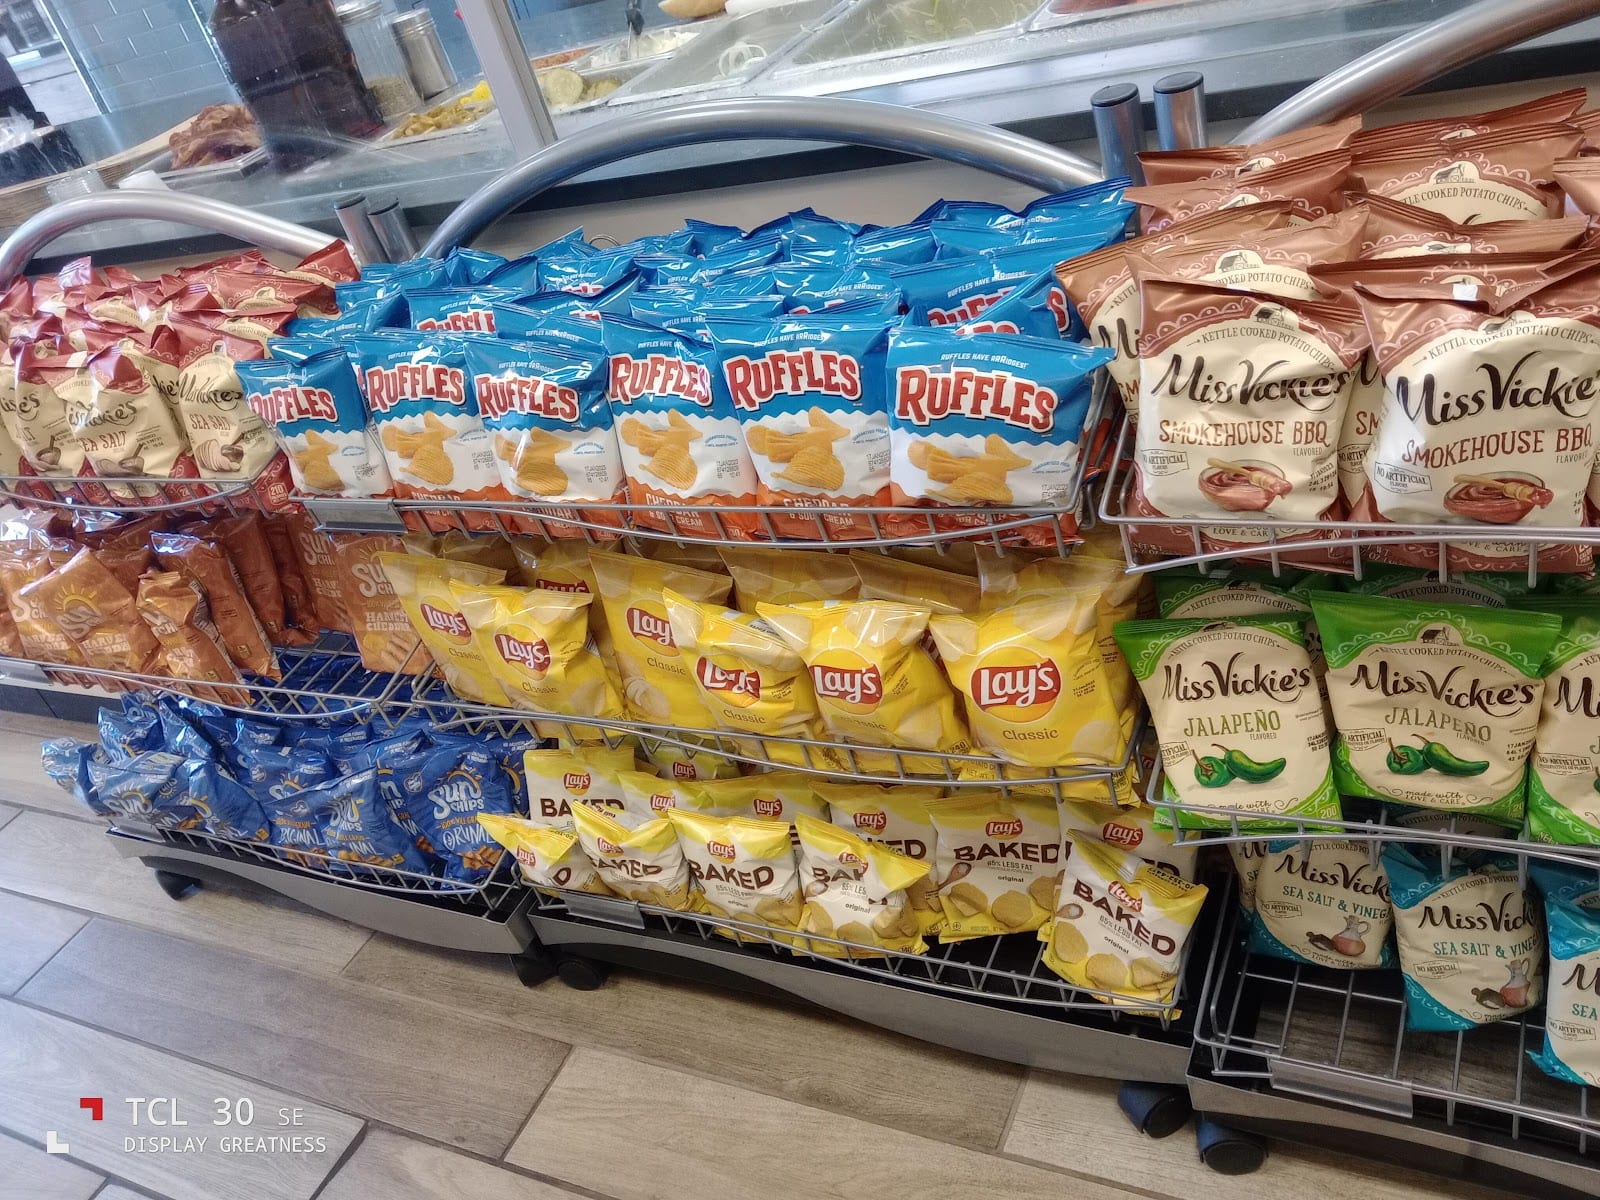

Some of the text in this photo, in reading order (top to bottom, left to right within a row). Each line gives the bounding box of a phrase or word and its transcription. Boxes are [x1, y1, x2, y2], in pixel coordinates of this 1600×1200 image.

[1421, 186, 1525, 210] COOKED POTATO CHIPS
[975, 278, 990, 287] HAVE
[1215, 272, 1312, 291] OOKED POTATO CHIPS
[780, 334, 795, 342] HAVE
[1428, 326, 1592, 359] KETTLE COOKED POTATO CHIPS
[941, 353, 970, 361] RUFFLES
[972, 353, 989, 361] HAVE
[1202, 327, 1334, 370] KETTLE COOKED POTATO CHIPS
[366, 364, 464, 411] RUFFLES
[610, 356, 710, 405] RUFFLES
[726, 351, 859, 408] RUFFLES
[1475, 350, 1600, 419] Vickie'
[476, 376, 579, 421] RUFFLES
[897, 367, 1055, 431] RUFFLES
[100, 431, 127, 449] SALT
[1159, 420, 1285, 447] SMOKEHOUSE
[1292, 421, 1331, 448] BBQ
[1402, 423, 1592, 469] SMOKEHOUSE BBQ
[1386, 471, 1428, 485] ARTIFICIAL
[824, 513, 853, 525] CREAM
[1213, 527, 1236, 536] LOVE
[1251, 529, 1269, 537] CAR
[1191, 593, 1296, 612] KETTLE COOKED POTATO CHIPS
[1193, 632, 1222, 647] COOKED
[1223, 632, 1252, 641] POTATO
[1253, 636, 1278, 648] CHIPS
[500, 633, 546, 669] Lay's
[1409, 647, 1445, 656] COOKED
[1445, 648, 1479, 661] POTATO
[647, 657, 686, 676] Classic
[815, 665, 877, 704] Lay's
[980, 662, 1054, 708] Lay's
[1162, 651, 1311, 703] Miss Vickie's
[522, 681, 558, 694] Classic
[1350, 660, 1536, 718] Miss Vickie's
[723, 709, 766, 724] Classic
[1184, 709, 1281, 737] JALAPEÑO
[1384, 706, 1492, 743] JALAPEÑO
[1002, 728, 1060, 742] Classic
[1550, 757, 1590, 766] ARTIFICIAL
[565, 773, 591, 790] Lay's
[1435, 790, 1464, 800] with
[450, 798, 485, 813] CHIPS
[1320, 807, 1337, 818] 200
[856, 813, 886, 830] Lay's
[988, 822, 1021, 836] Lay's
[1105, 823, 1142, 845] Lay's
[710, 841, 735, 858] Lay's
[954, 842, 1059, 864] BAKED
[588, 855, 662, 878] AKED
[688, 859, 774, 890] BAKED
[1002, 861, 1020, 869] LESS
[1021, 863, 1033, 871] FAT
[1274, 854, 1339, 884] Miss
[998, 875, 1024, 883] original
[854, 885, 867, 895] LES
[1283, 885, 1304, 900] SEA
[1307, 891, 1336, 907] SALT
[1338, 899, 1348, 913] &
[1440, 883, 1465, 897] KETTLE
[845, 903, 871, 914] original
[1073, 879, 1176, 956] BAKED
[1271, 904, 1300, 912] ARTIFICIAL
[1100, 914, 1113, 927] 65%
[1114, 923, 1131, 938] LESS
[1418, 905, 1490, 931] Miss
[1104, 936, 1129, 954] original
[1433, 941, 1507, 960] SEA SALT &
[1427, 965, 1457, 973] ARTIFICIAL
[1572, 1003, 1598, 1021] SEA
[1559, 1025, 1592, 1034] ARTIFICIAL
